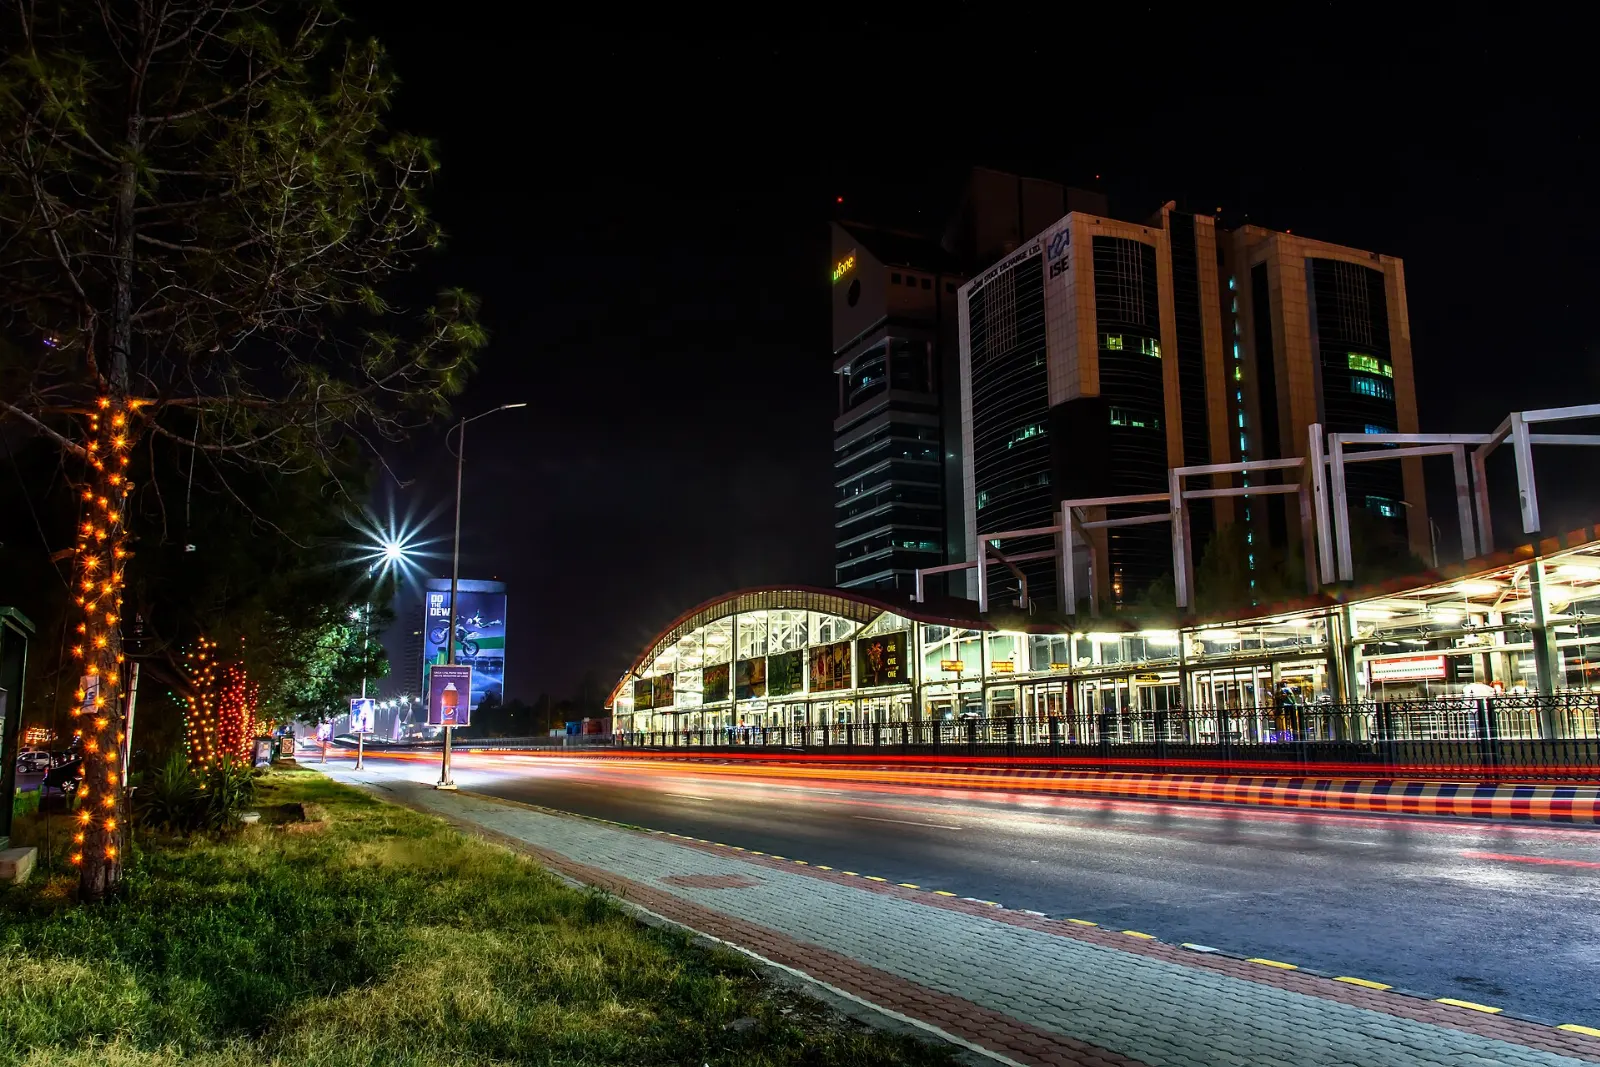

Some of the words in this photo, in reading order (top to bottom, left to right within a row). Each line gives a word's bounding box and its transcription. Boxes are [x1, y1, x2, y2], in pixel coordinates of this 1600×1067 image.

[999, 250, 1028, 272] EXCHANGE
[1049, 255, 1069, 280] ISE
[430, 594, 443, 603] DO
[430, 607, 451, 617] DEW
[887, 644, 896, 652] ONE
[887, 657, 897, 665] ONE
[887, 670, 897, 678] ONE
